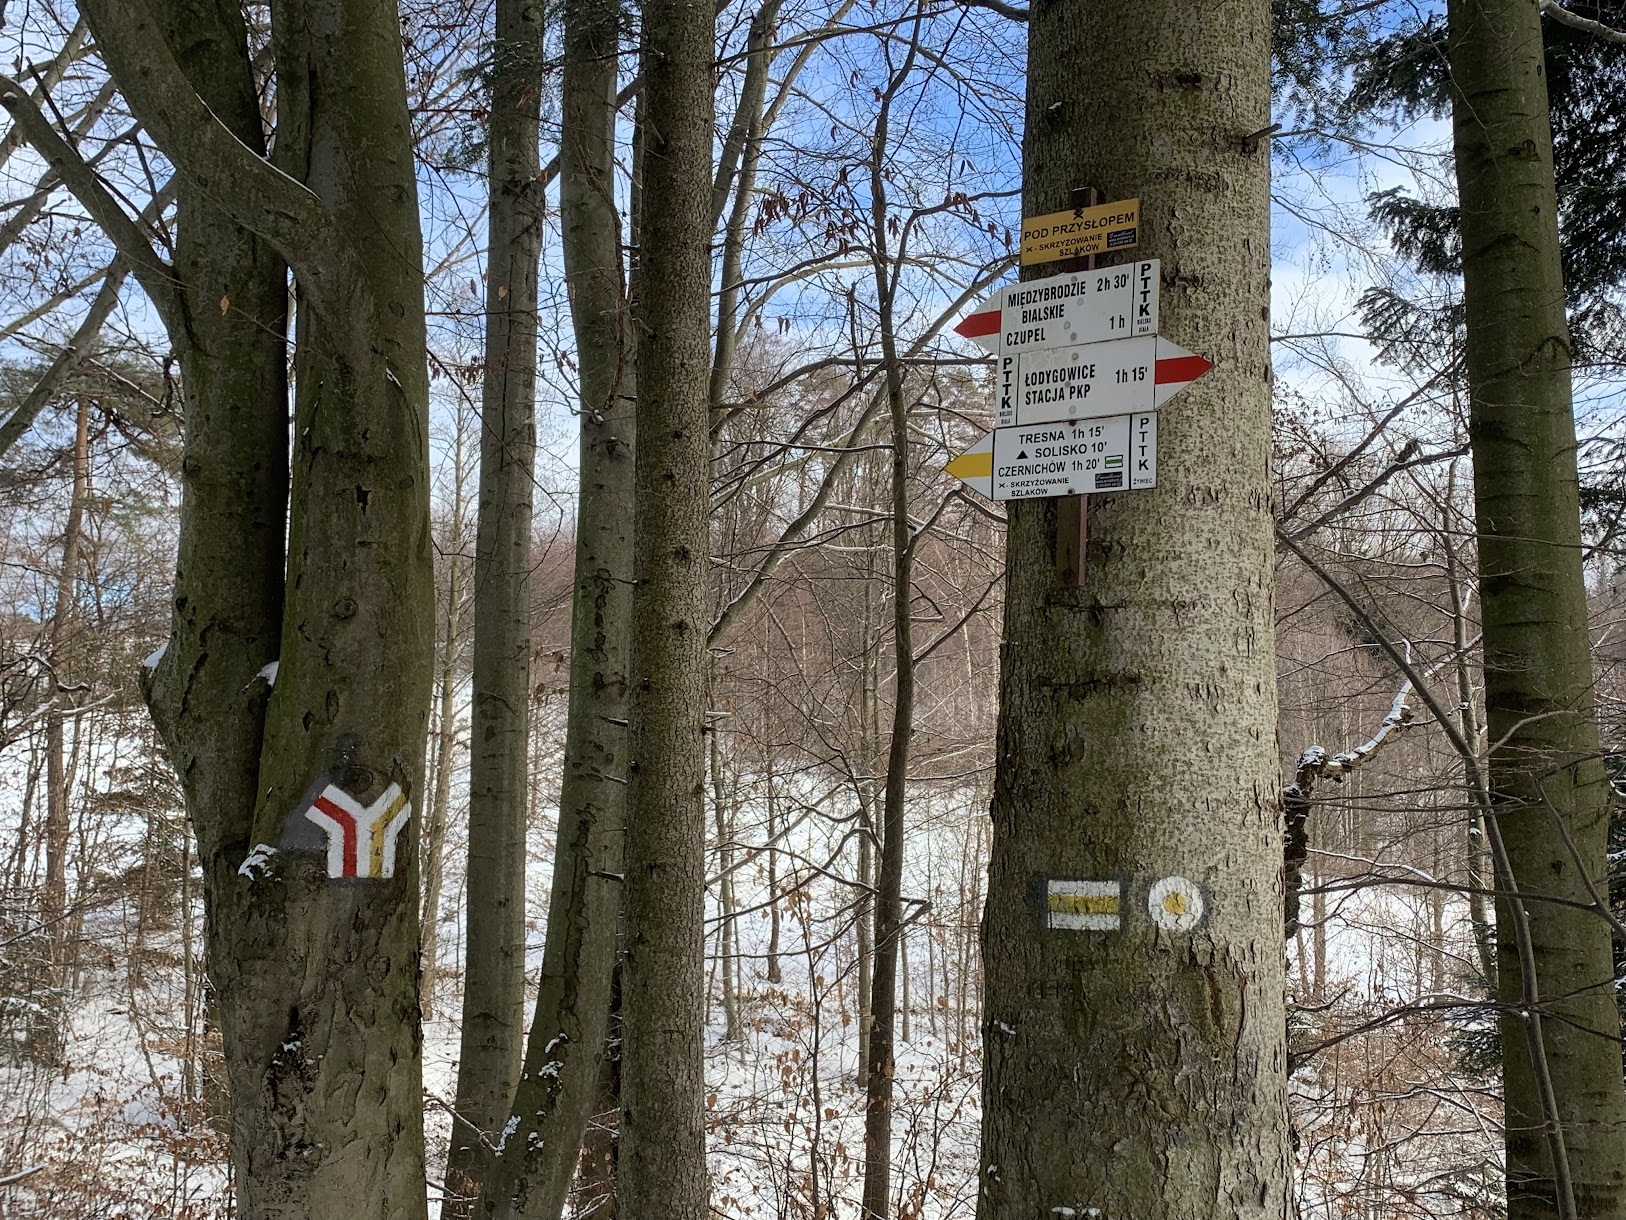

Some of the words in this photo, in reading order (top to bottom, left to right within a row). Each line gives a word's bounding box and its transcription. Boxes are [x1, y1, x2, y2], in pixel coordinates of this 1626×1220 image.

[1024, 228, 1049, 241] POD
[1052, 212, 1135, 236] PRZYSŁOPEM
[1039, 233, 1103, 251] SKRZYŻOWANIE
[1059, 243, 1100, 257] SZLAKÓW
[1008, 281, 1086, 309] MIĘDZYBRODZIE
[1097, 277, 1110, 292] 2h
[1114, 273, 1130, 289] 30'
[1022, 304, 1065, 324] BIALSKIE
[1006, 327, 1046, 347] CZUPEL
[1025, 364, 1096, 387] ŁODYGOWICE
[1115, 368, 1128, 384] 1h
[1132, 366, 1148, 382] 15'
[1025, 387, 1065, 405] STACJA
[1069, 384, 1091, 400] PKP
[1019, 430, 1066, 445] TRESNA
[1071, 428, 1085, 440] 1h
[1088, 425, 1105, 438] 15'
[1035, 443, 1088, 459] SOLISKO
[1091, 441, 1107, 453] 10'
[998, 460, 1066, 478] CZERNICHÓW
[1071, 460, 1083, 471] 1h
[1085, 458, 1100, 470] 20'
[1010, 477, 1070, 489] SKRZYŻOWANIE
[1011, 487, 1048, 497] SZLAKÓW
